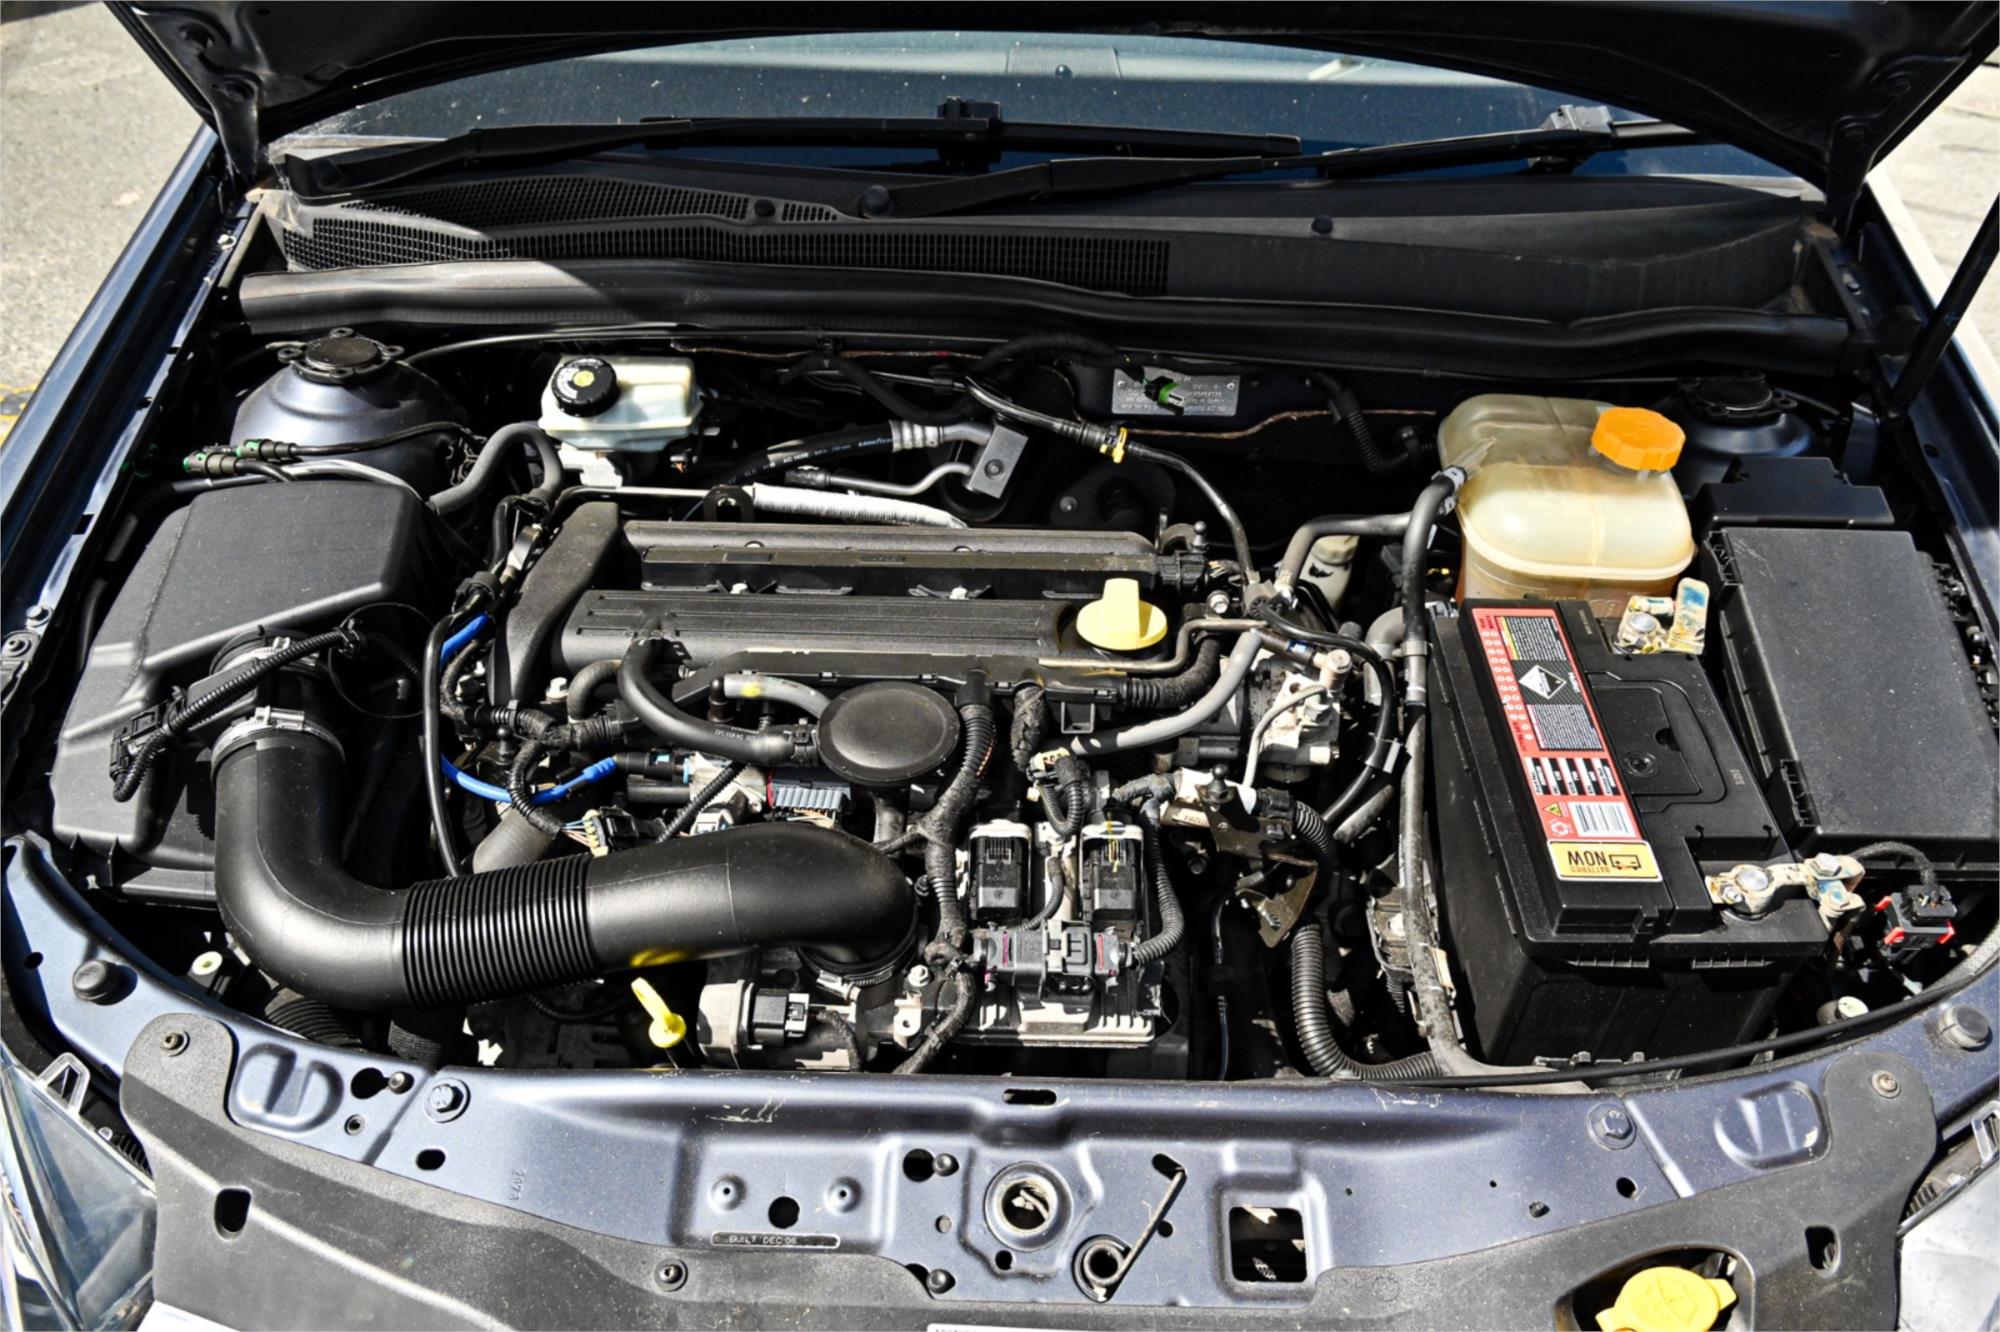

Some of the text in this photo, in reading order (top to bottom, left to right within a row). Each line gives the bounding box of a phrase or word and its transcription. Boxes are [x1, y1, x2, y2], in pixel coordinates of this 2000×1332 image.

[1567, 850, 1608, 867] NOW
[729, 1235, 757, 1244] BUILT
[763, 1236, 782, 1245] DEC
